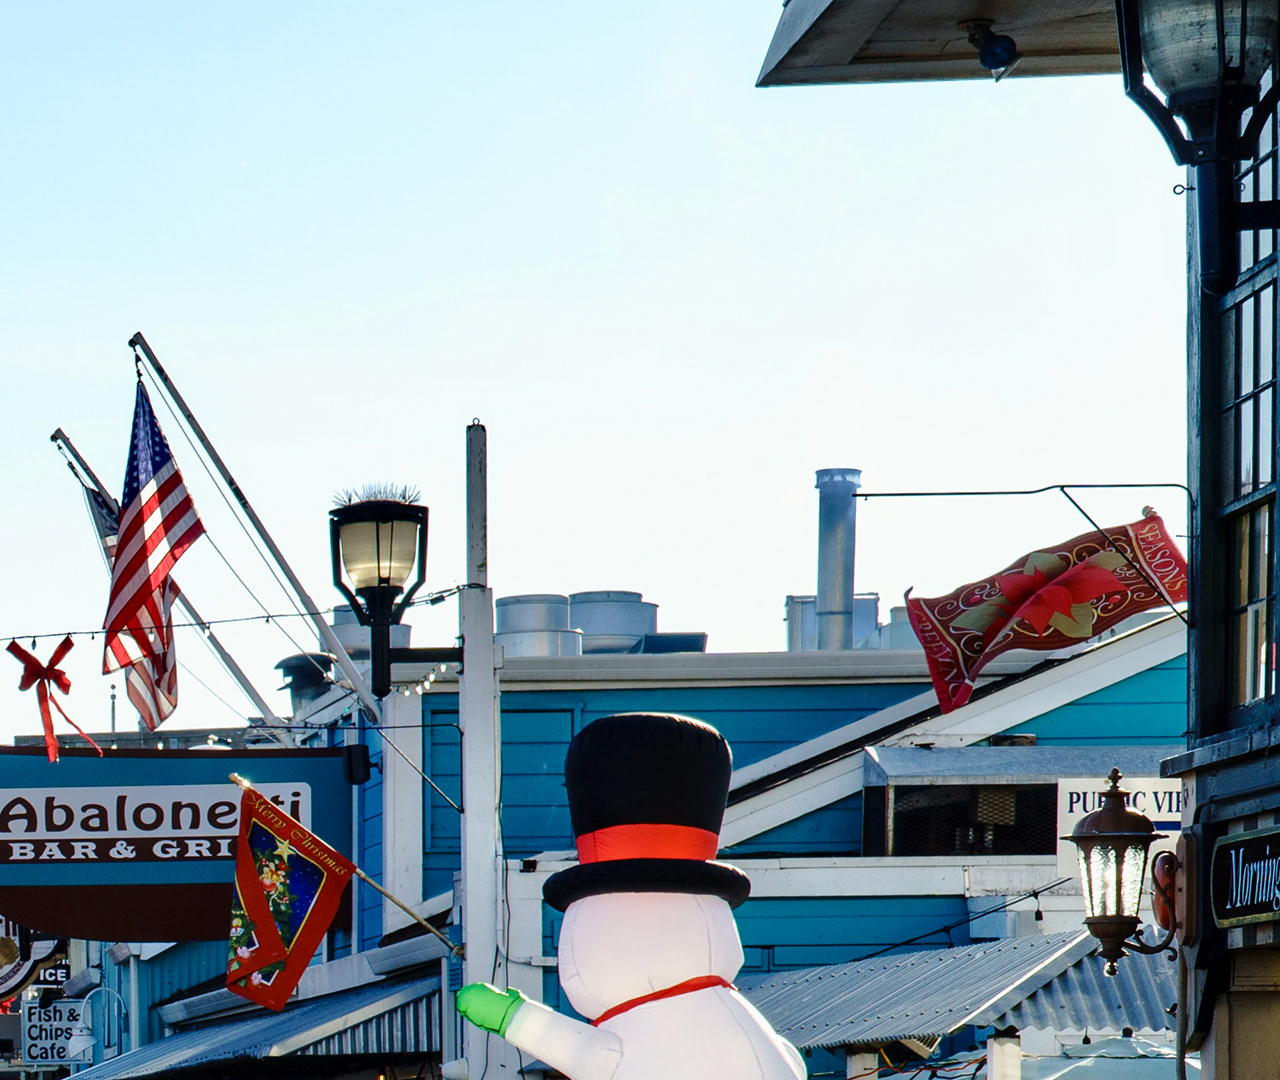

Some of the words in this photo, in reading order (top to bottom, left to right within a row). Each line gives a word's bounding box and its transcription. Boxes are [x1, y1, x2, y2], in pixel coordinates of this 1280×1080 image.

[914, 609, 964, 700] GREETIN
[1068, 791, 1147, 814] PUIC
[246, 791, 287, 829] Merry
[290, 829, 348, 875] Christmas
[8, 841, 100, 861] BAR
[109, 840, 136, 859] &
[152, 839, 233, 858] GRI
[40, 968, 67, 981] ICE
[27, 1006, 63, 1022] Fish
[66, 1009, 81, 1022] &
[27, 1024, 73, 1042] Chips
[27, 1043, 67, 1060] Cafe
